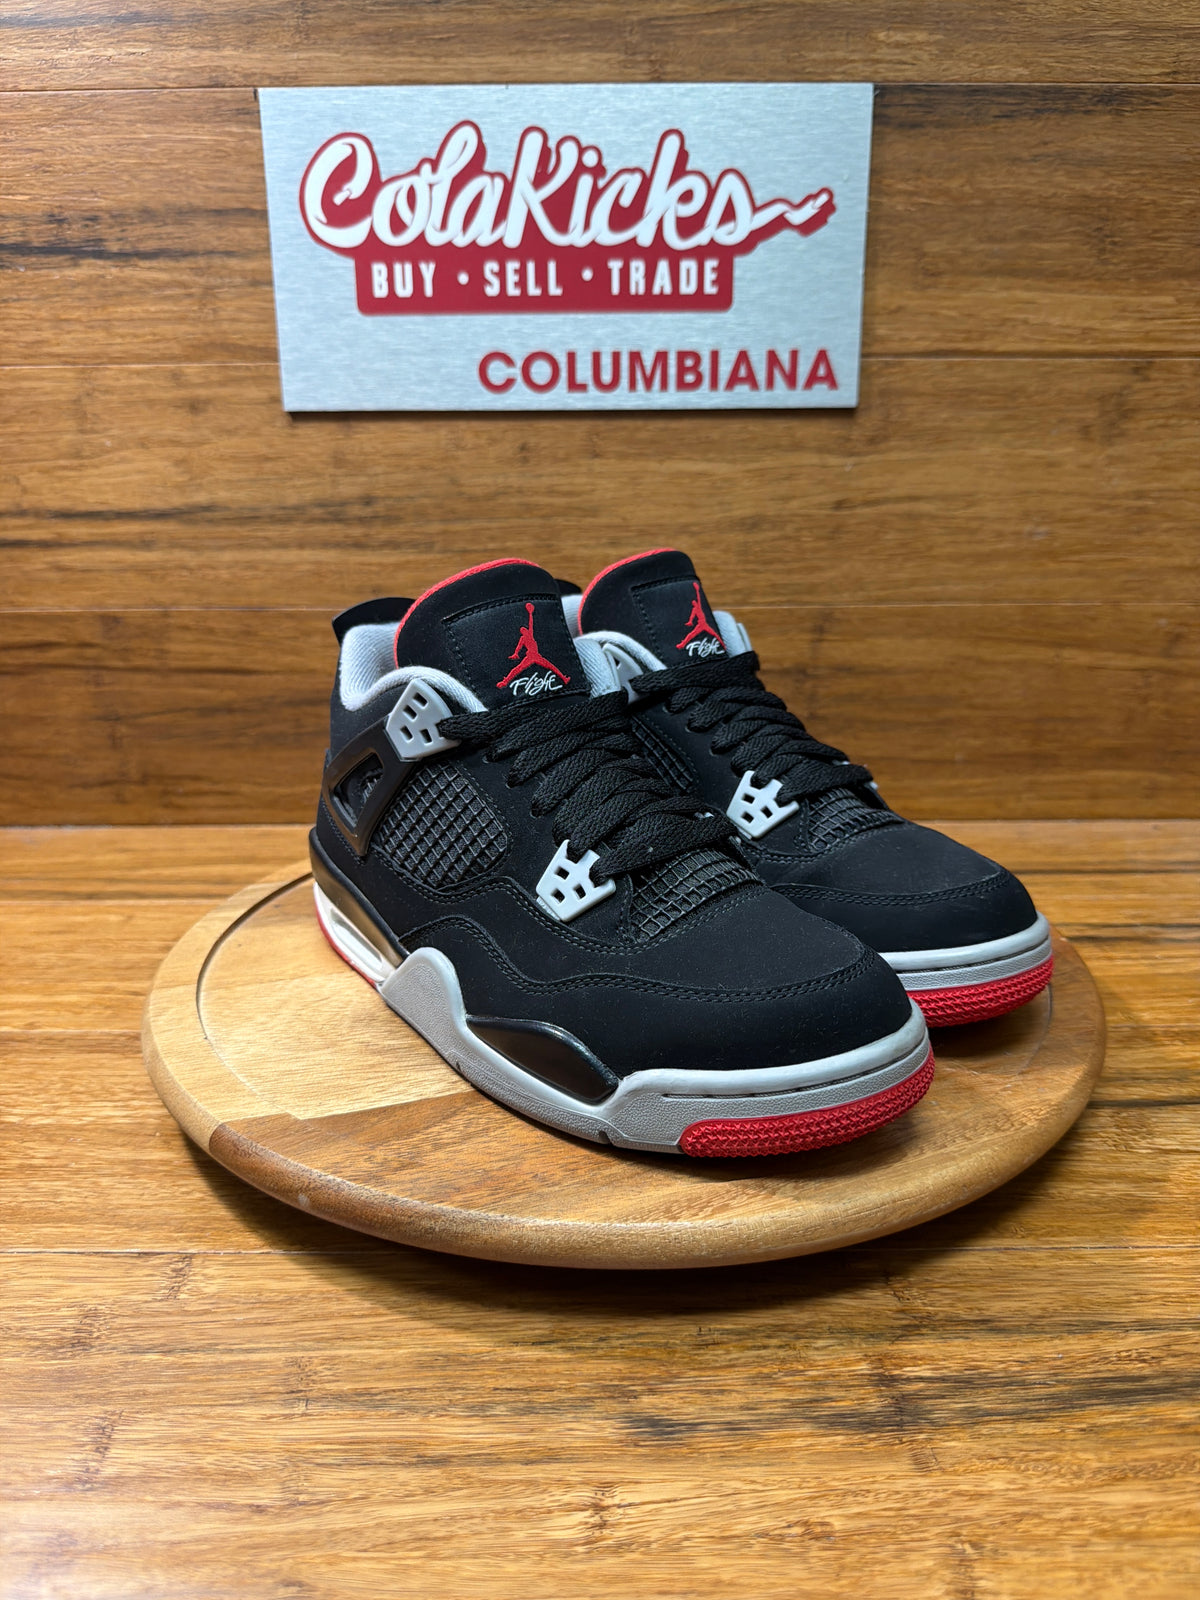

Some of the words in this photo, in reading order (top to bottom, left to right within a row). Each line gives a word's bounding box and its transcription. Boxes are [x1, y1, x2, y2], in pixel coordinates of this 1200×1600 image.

[301, 121, 834, 251] ColaKicks
[372, 262, 436, 298] BUY
[483, 260, 563, 297] SELL
[608, 258, 720, 296] TRADE
[478, 349, 838, 394] COLUMBIANA
[686, 637, 725, 658] Flight
[510, 671, 563, 696] Flight
